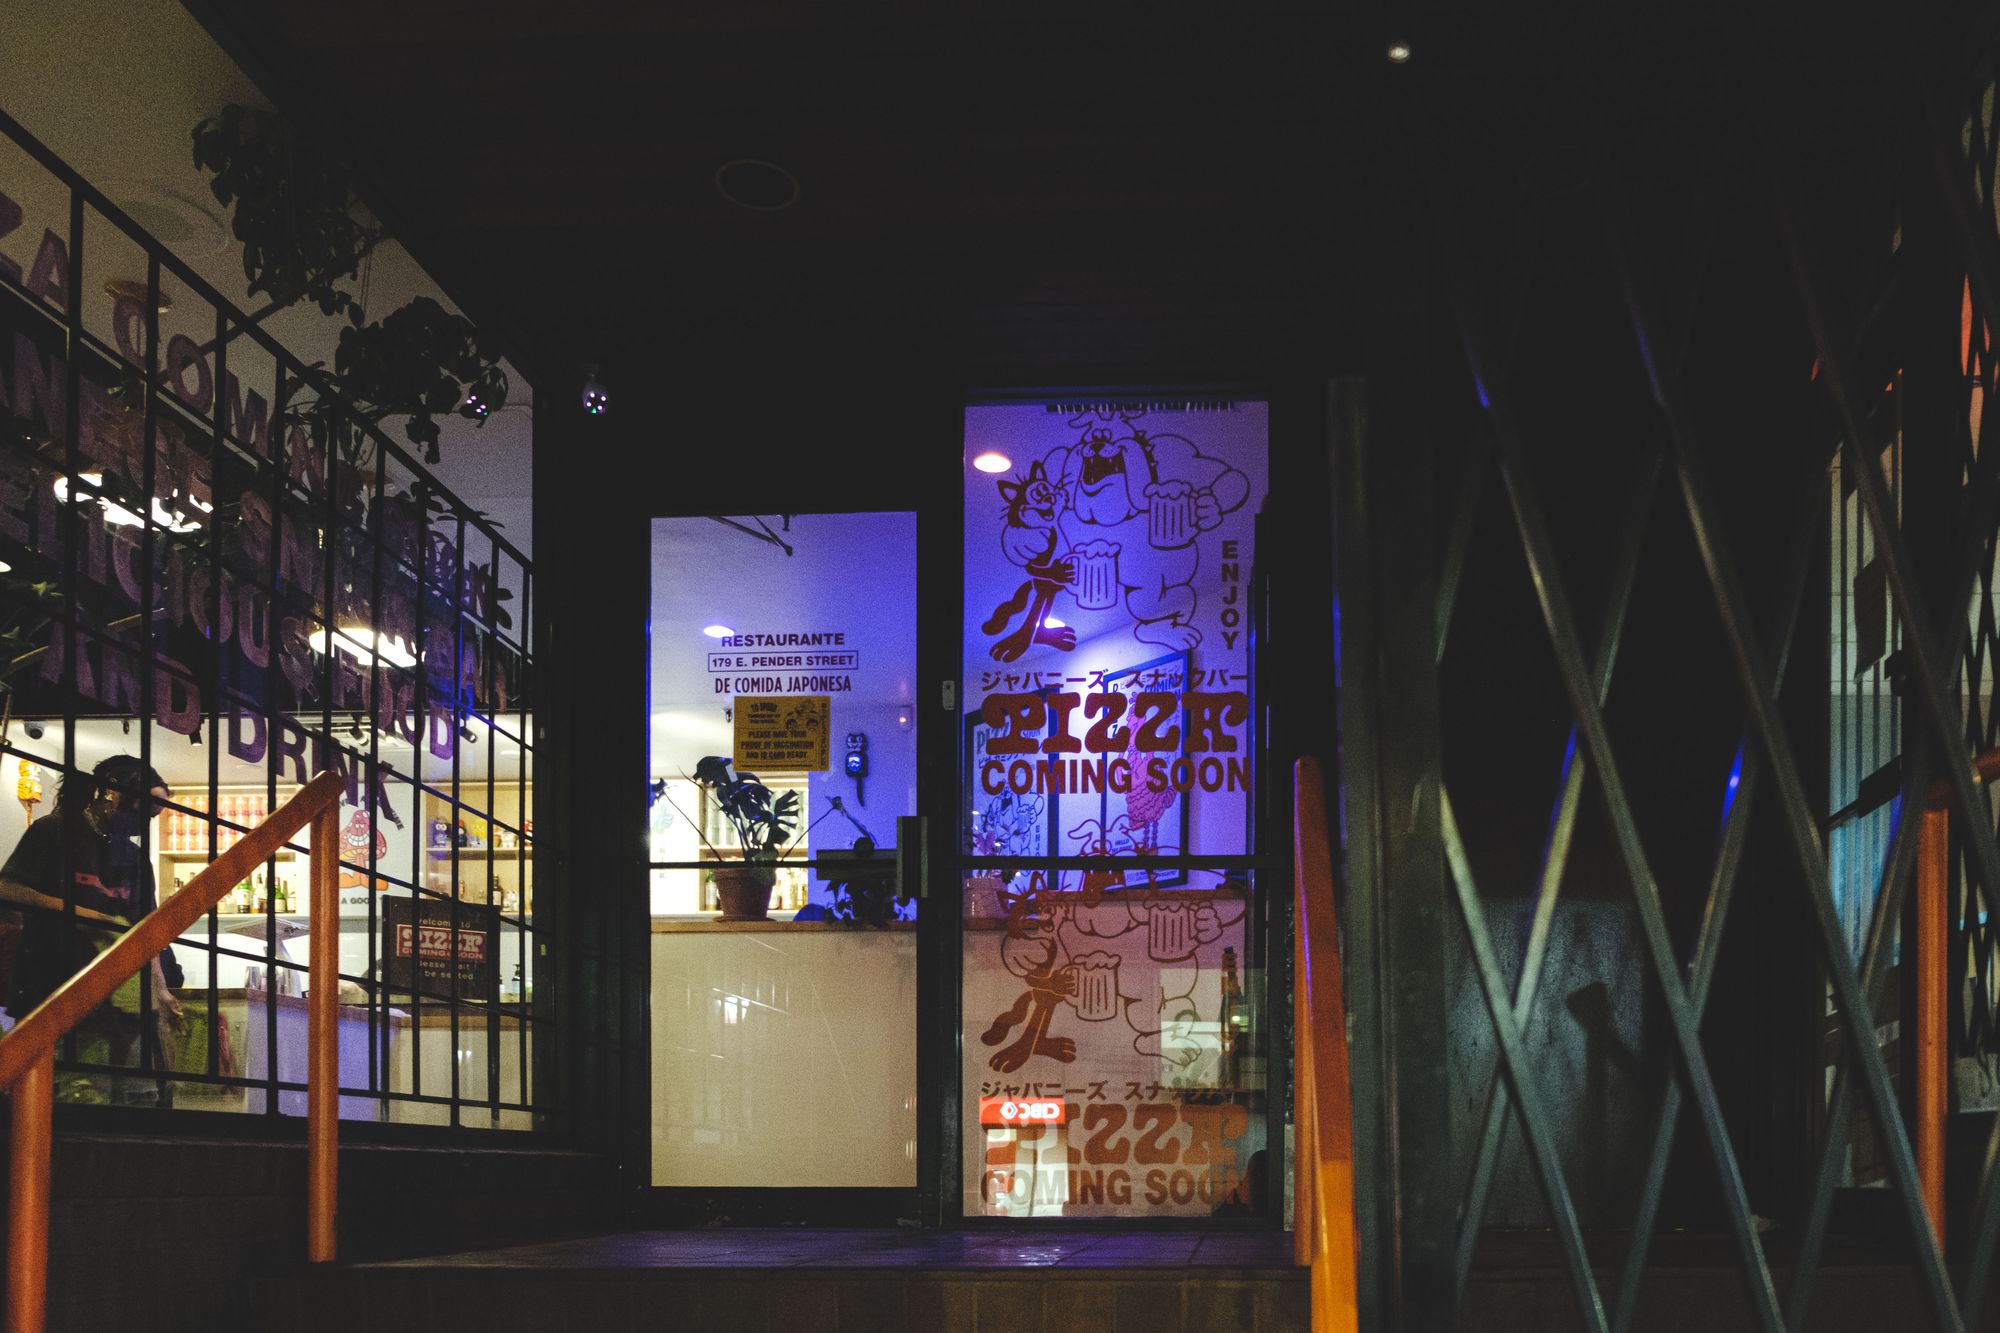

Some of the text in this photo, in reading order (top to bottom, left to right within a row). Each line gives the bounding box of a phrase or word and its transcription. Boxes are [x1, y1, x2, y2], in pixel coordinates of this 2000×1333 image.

[1221, 540, 1240, 651] ENJOY
[721, 632, 845, 647] RESTAURANTE
[712, 655, 854, 667] 179 E. PENDER STREET
[715, 675, 852, 693] DE COMIDA JAPONESA
[981, 669, 1109, 691] ジャパニーズ
[1125, 667, 1248, 689] スナックバー
[981, 757, 1133, 795] COMING
[1147, 756, 1249, 793] SOON
[350, 897, 370, 905] GOO
[440, 972, 474, 980] seted
[981, 1080, 1108, 1101] ジャパニーズ
